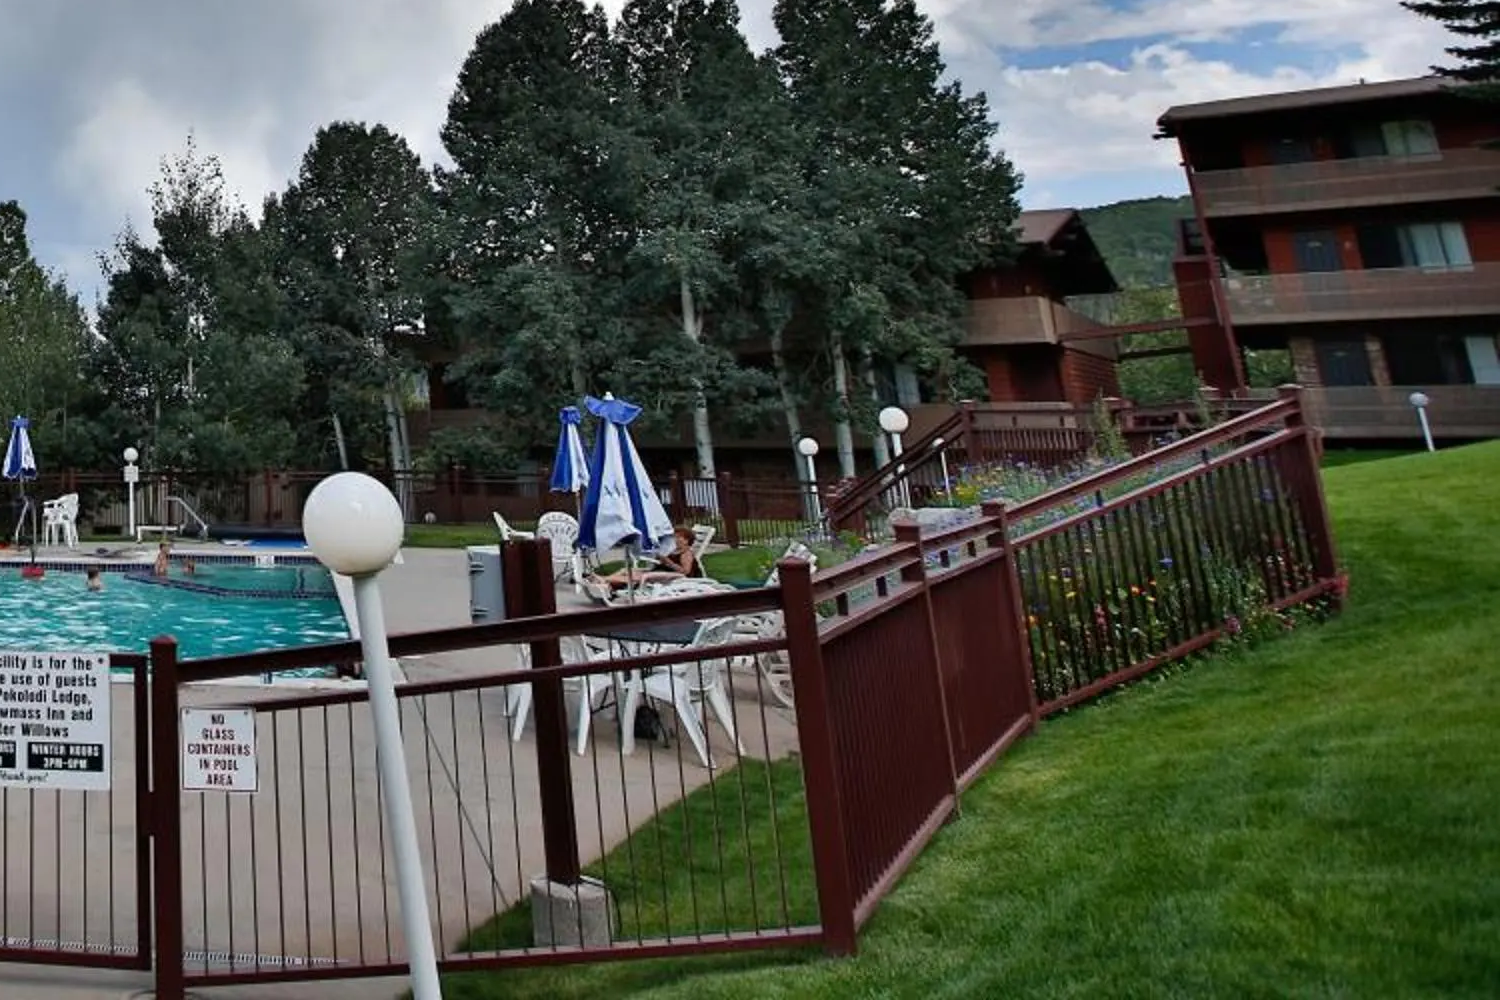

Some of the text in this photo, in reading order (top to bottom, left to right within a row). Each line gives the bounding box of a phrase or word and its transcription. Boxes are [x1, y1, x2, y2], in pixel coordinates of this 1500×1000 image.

[32, 656, 43, 669] is
[49, 656, 67, 670] for
[73, 656, 93, 670] the
[11, 675, 33, 685] use
[37, 673, 50, 687] of
[55, 674, 97, 688] guests
[47, 707, 65, 720] Inn
[71, 708, 93, 721] and
[211, 714, 225, 725] NO
[21, 723, 69, 737] Willows
[202, 727, 235, 740] GLASS
[31, 743, 66, 756] WINTER
[187, 743, 251, 756] CONTAINERS
[199, 759, 239, 770] IN POOL
[206, 773, 233, 786] AREA
